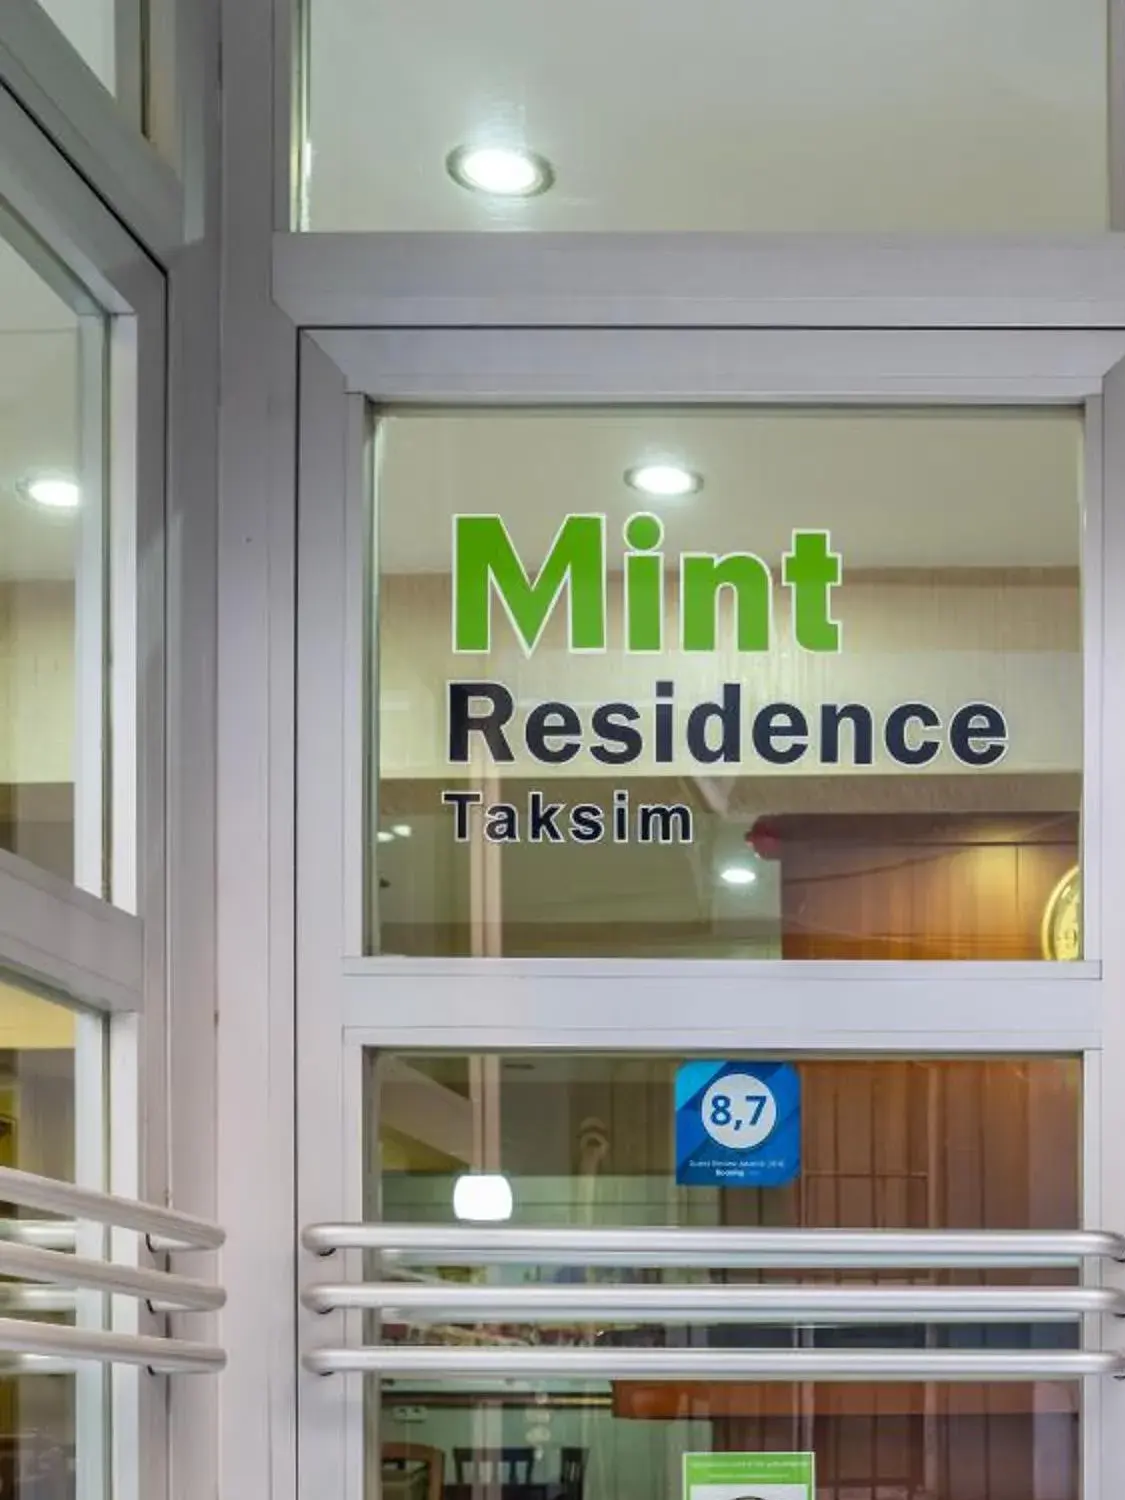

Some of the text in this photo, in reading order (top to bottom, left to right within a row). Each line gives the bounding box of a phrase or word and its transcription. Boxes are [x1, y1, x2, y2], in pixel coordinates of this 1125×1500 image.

[452, 512, 842, 658] Mint
[445, 679, 1009, 767] Residence
[442, 790, 693, 844] Taksim
[710, 1095, 767, 1131] 8,7
